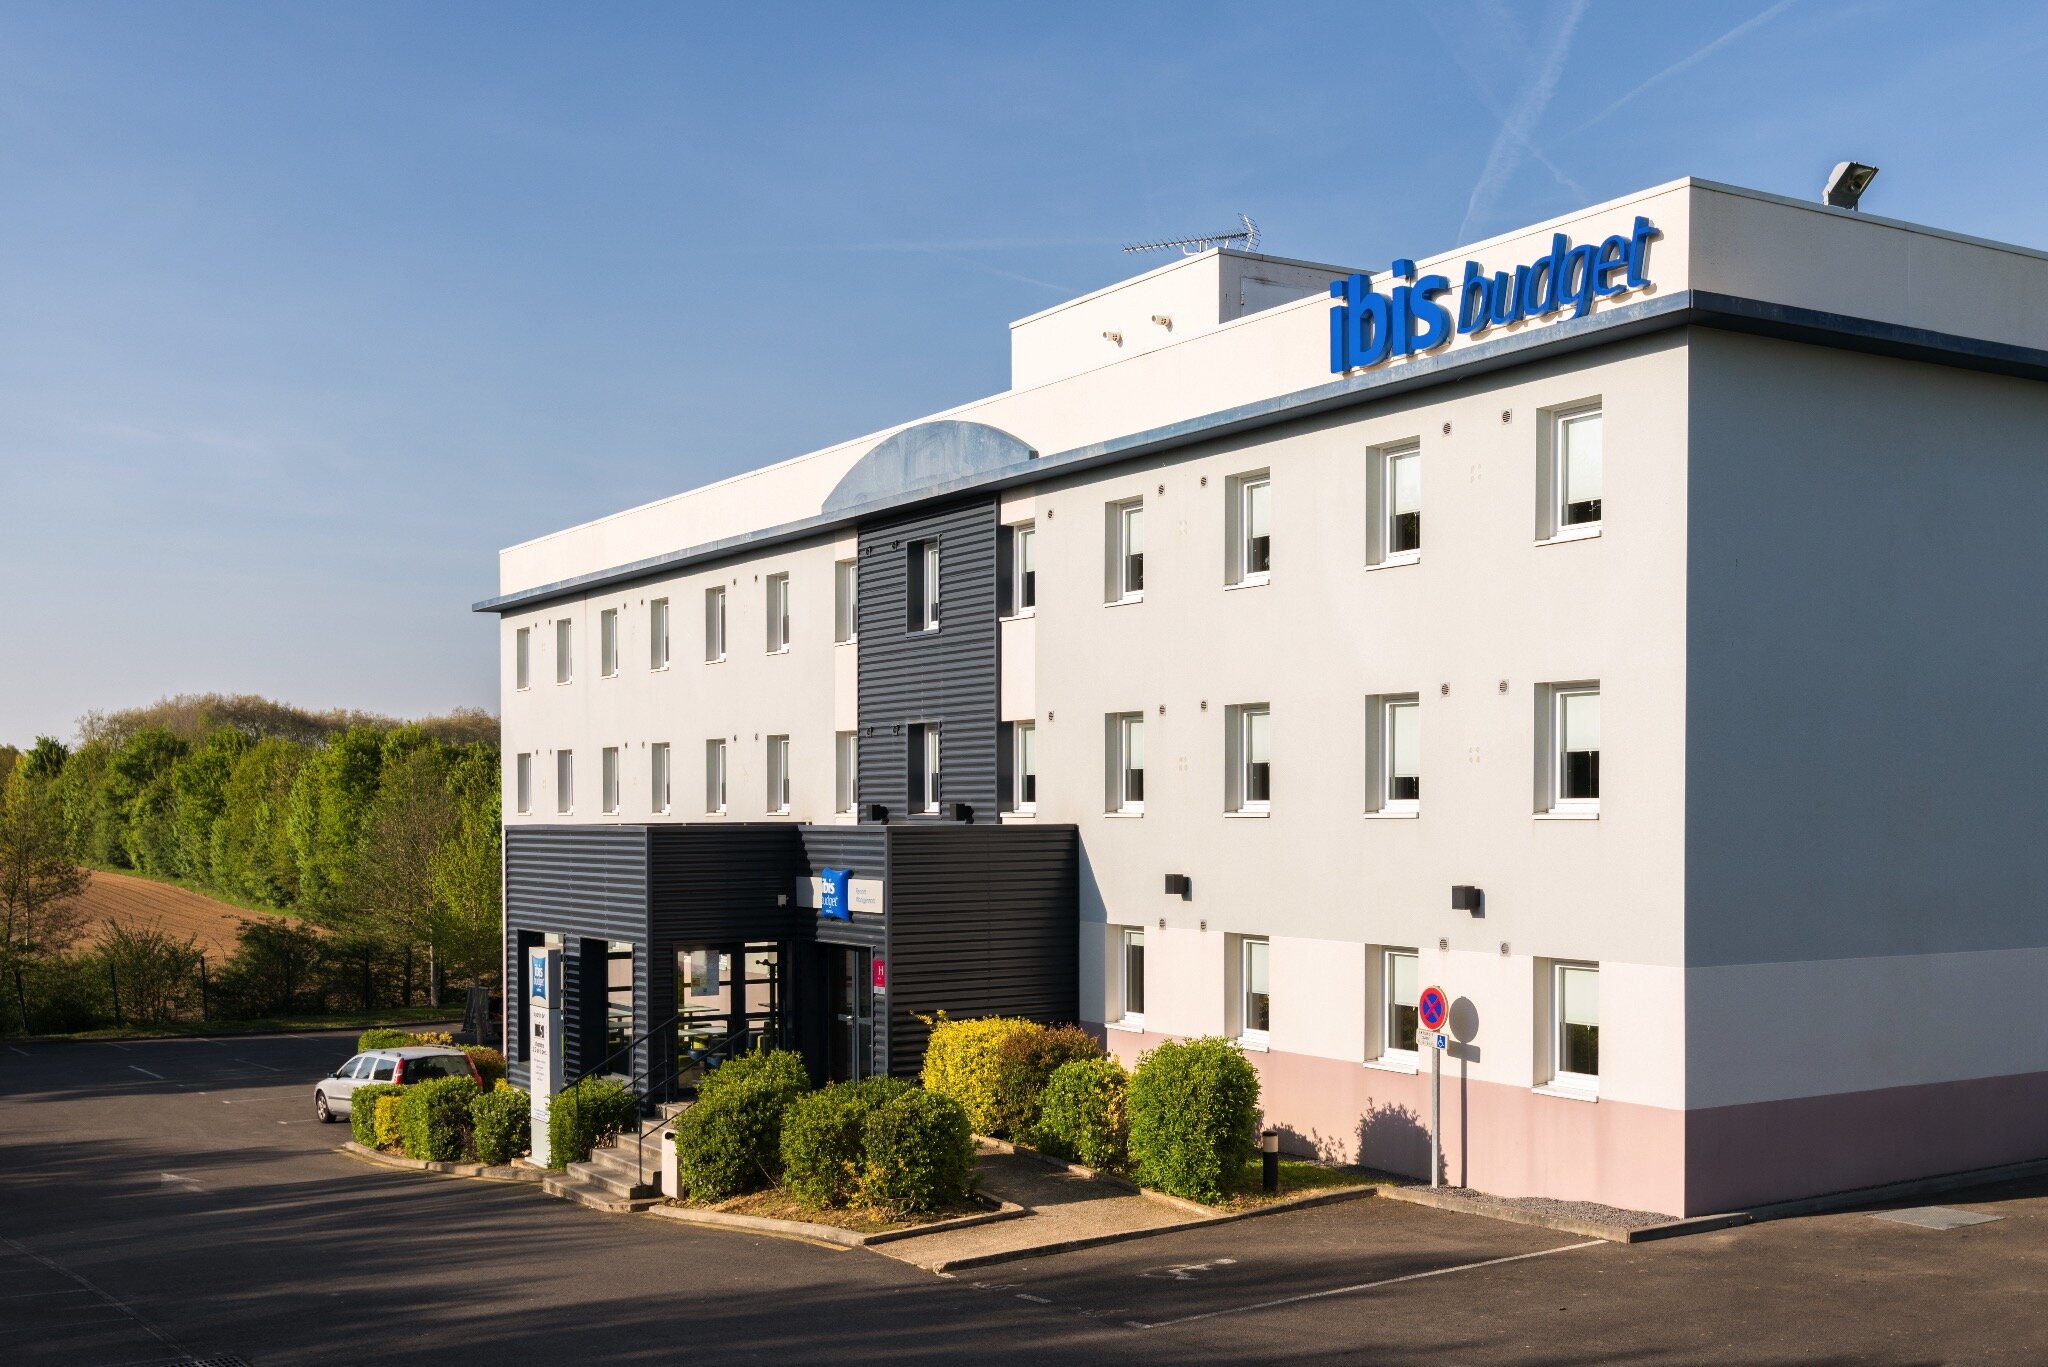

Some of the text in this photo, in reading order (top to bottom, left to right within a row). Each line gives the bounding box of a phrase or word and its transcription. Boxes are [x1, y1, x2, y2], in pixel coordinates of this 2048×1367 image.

[1330, 215, 1659, 374] ibis budget
[878, 965, 884, 976] H
